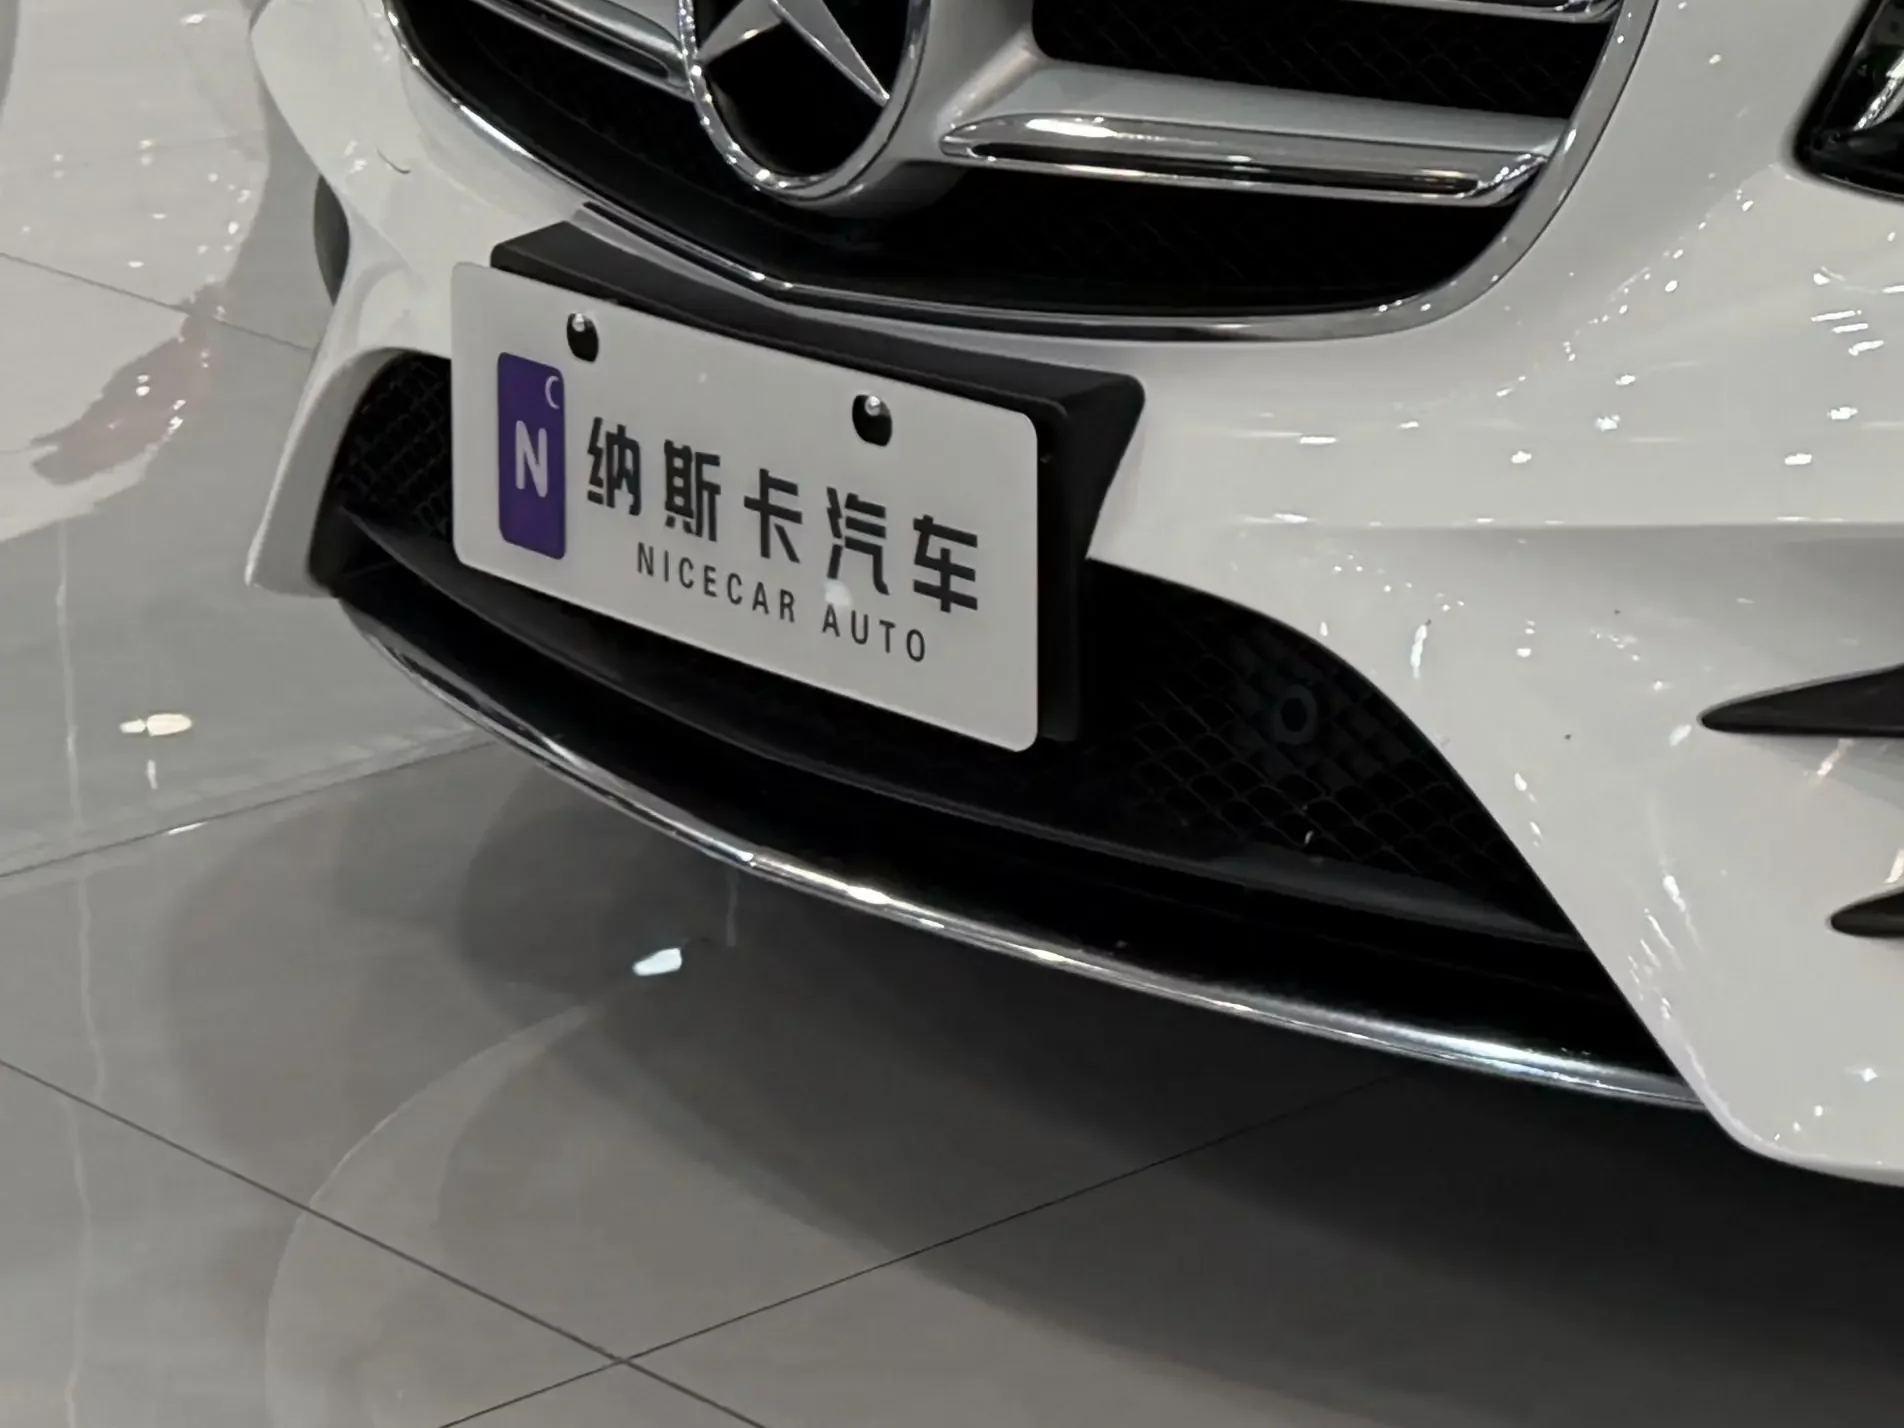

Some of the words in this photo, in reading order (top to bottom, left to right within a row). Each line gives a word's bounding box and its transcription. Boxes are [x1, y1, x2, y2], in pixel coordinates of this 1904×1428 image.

[514, 419, 549, 498] N
[586, 416, 979, 614] 纳斯卡汽车
[636, 541, 796, 624] NICECAR
[821, 603, 927, 663] AUTO
